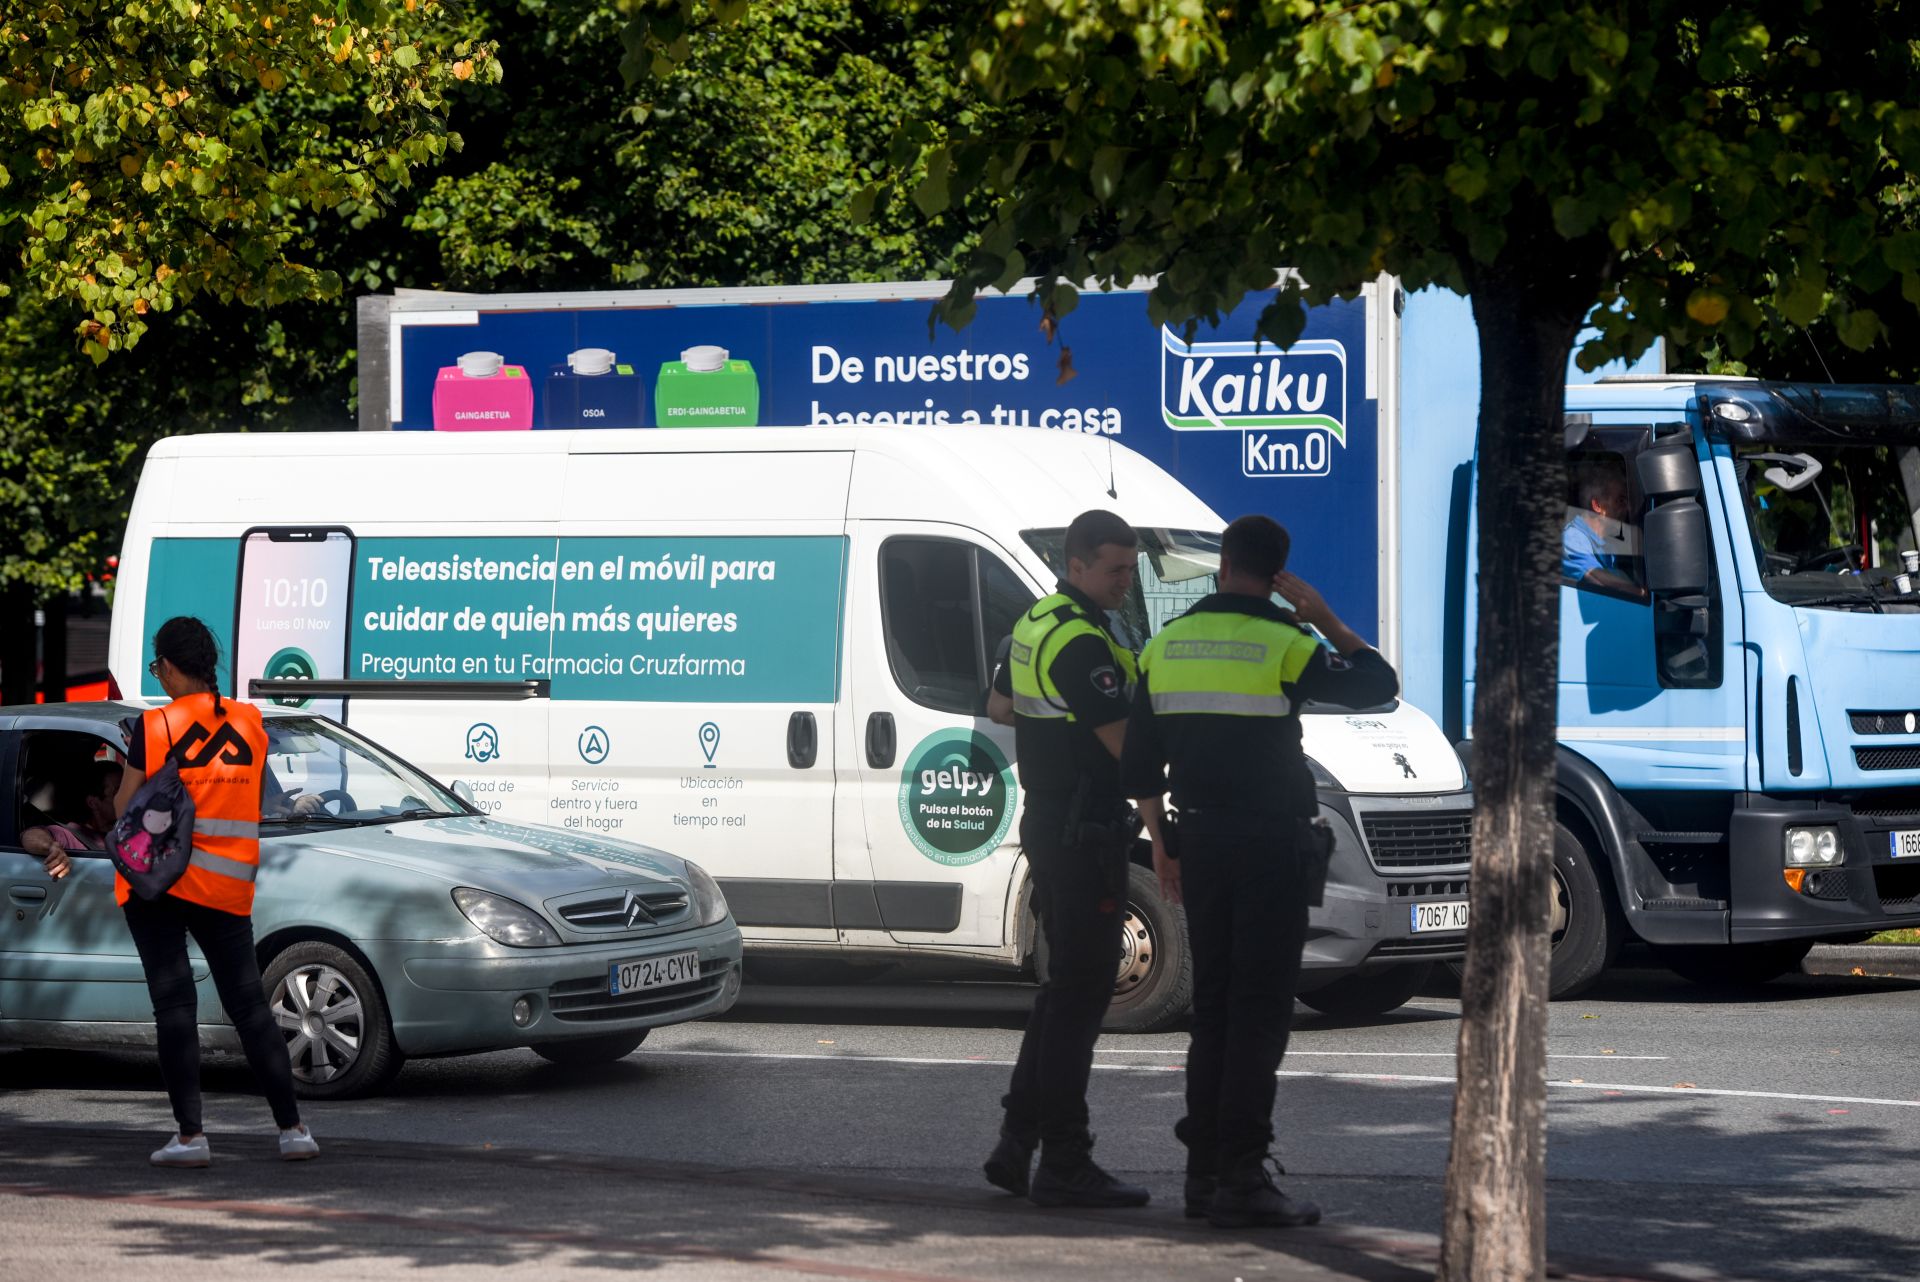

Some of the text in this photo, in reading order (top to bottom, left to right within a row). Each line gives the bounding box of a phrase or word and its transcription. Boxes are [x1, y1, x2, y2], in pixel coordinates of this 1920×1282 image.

[811, 346, 1029, 383] De nuestros
[1179, 357, 1329, 428] Kaiku
[455, 411, 511, 420] GAINGABETUA
[582, 409, 605, 418] OSOA
[667, 406, 746, 416] ERDI-GAINGABETUA
[1039, 407, 1122, 435] casa
[1247, 433, 1326, 472] Km.0
[368, 553, 776, 588] Teleasistencia en el móvil para
[263, 578, 329, 608] 10:10
[256, 618, 331, 631] Lunes 01 Nov
[364, 604, 738, 640] cuidar de quien más quieres
[361, 653, 746, 680] Pregunta en tu Farmacia Cruzfarma
[468, 780, 515, 792] idad de
[571, 780, 619, 792] Servicio
[680, 776, 744, 790] Ubicación
[920, 765, 994, 797] gelpy
[473, 800, 502, 814] oyo
[551, 797, 638, 812] dentro y fuera
[702, 798, 718, 807] en
[920, 804, 993, 817] Pulsa el botón
[564, 817, 624, 832] del hogar
[673, 812, 746, 828] tiempo real
[905, 822, 934, 857] exclusivo
[934, 853, 945, 862] en
[997, 787, 1016, 838] Cruzfarma
[927, 818, 985, 831] de la Salud
[1419, 904, 1468, 928] 7067 KD
[621, 954, 695, 990] 0724 CYV
